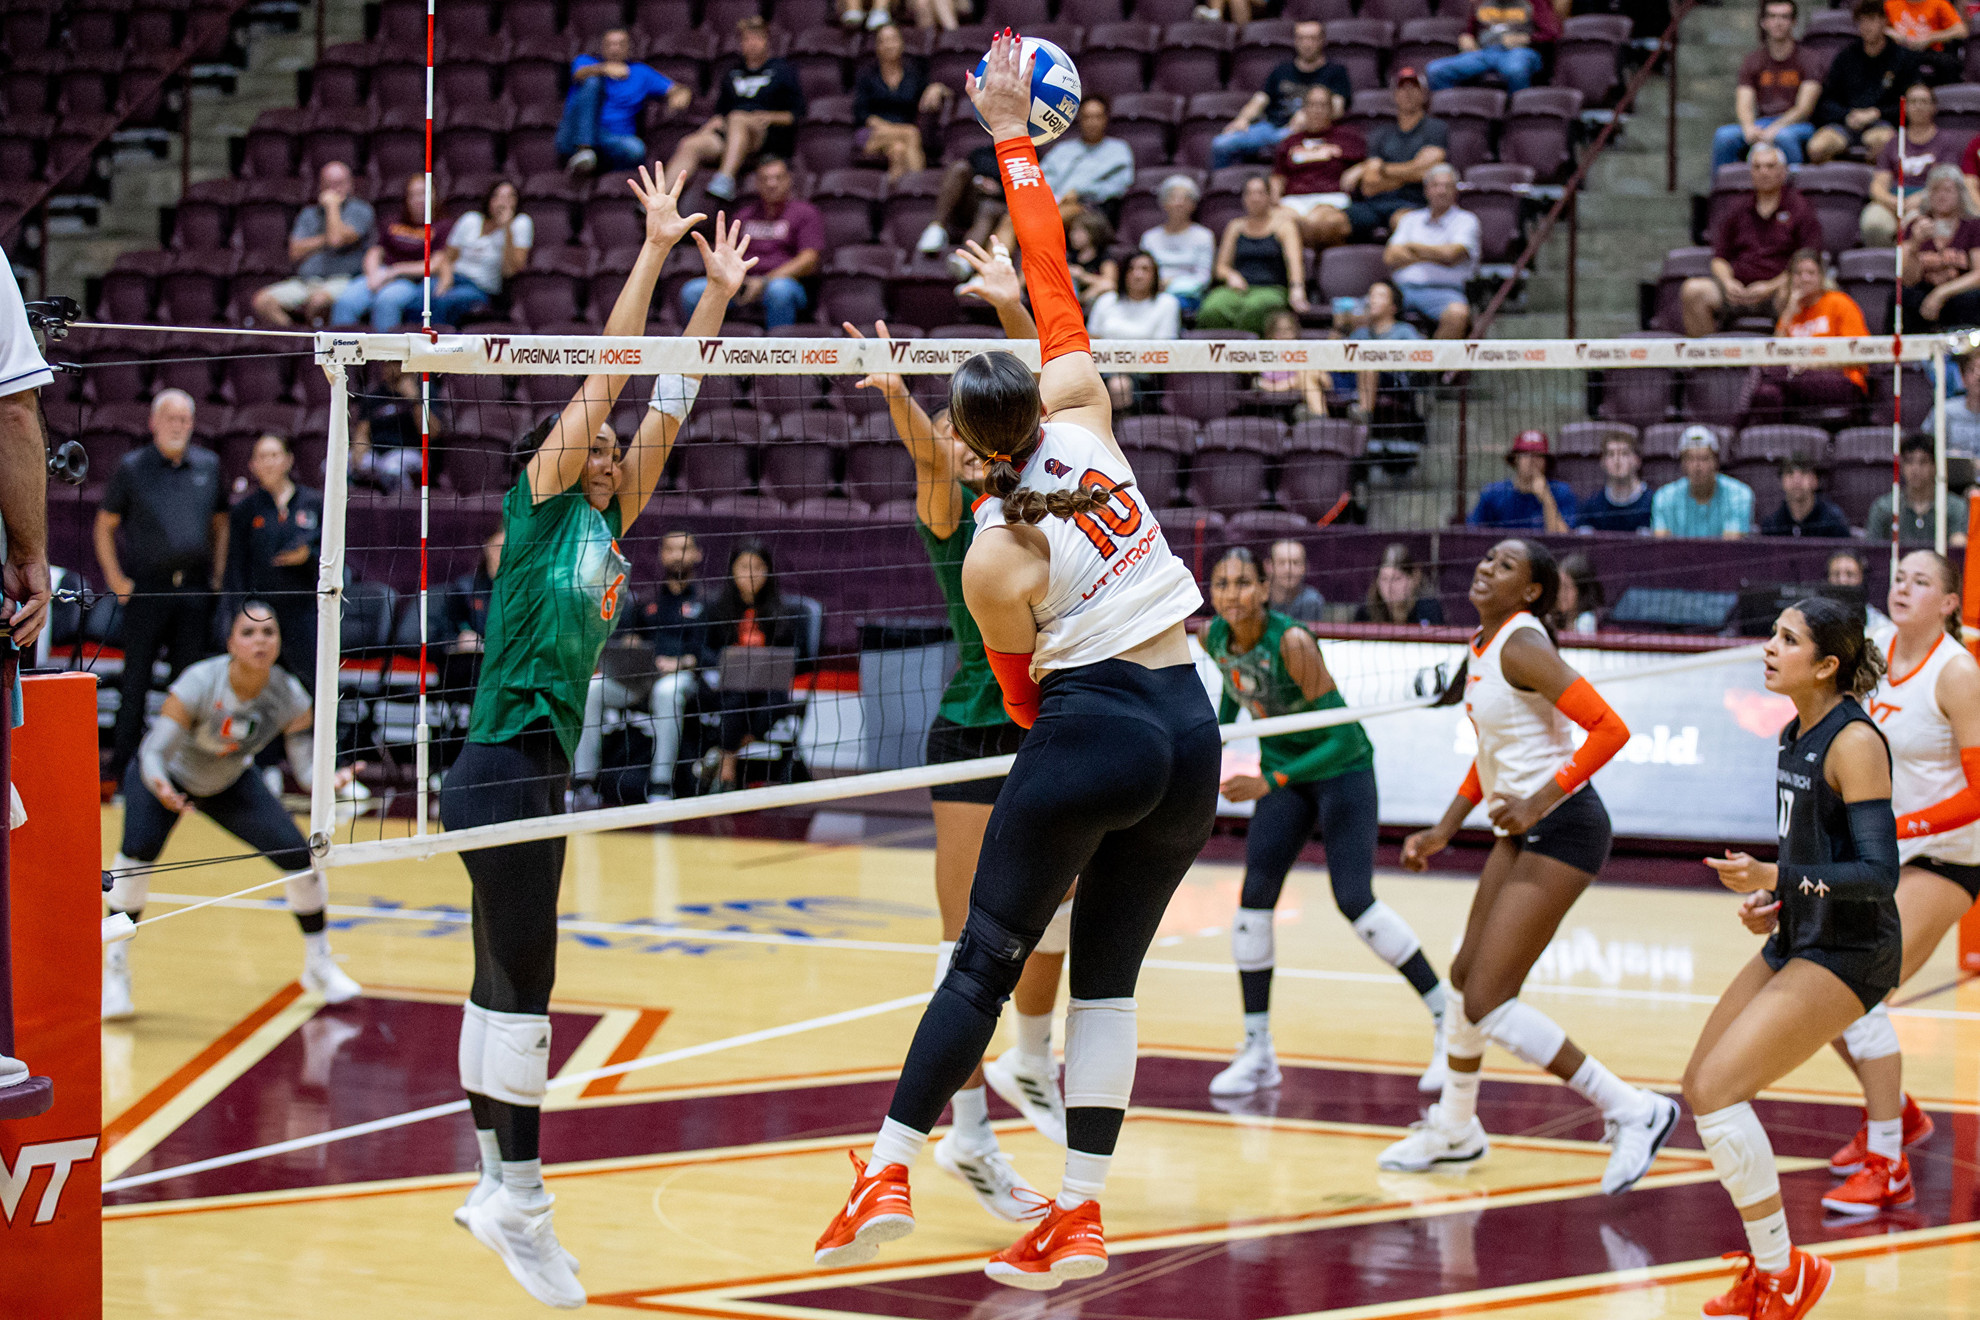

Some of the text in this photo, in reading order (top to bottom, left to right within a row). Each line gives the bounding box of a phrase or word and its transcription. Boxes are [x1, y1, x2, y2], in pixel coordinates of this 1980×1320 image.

[484, 338, 642, 364] VT VIRGINIA TECH HOKIES
[698, 339, 838, 364] VT VIRGINIA TECH HOKIES
[889, 341, 911, 363] VT
[910, 350, 950, 363] VIRGINIA
[1114, 351, 1137, 363] TECH
[1139, 350, 1169, 364] HOKIES
[1208, 343, 1226, 363] VT
[1281, 350, 1308, 363] HOKIES
[600, 572, 627, 621] 6
[1869, 697, 1903, 724] VT
[0, 1132, 101, 1230] VT
